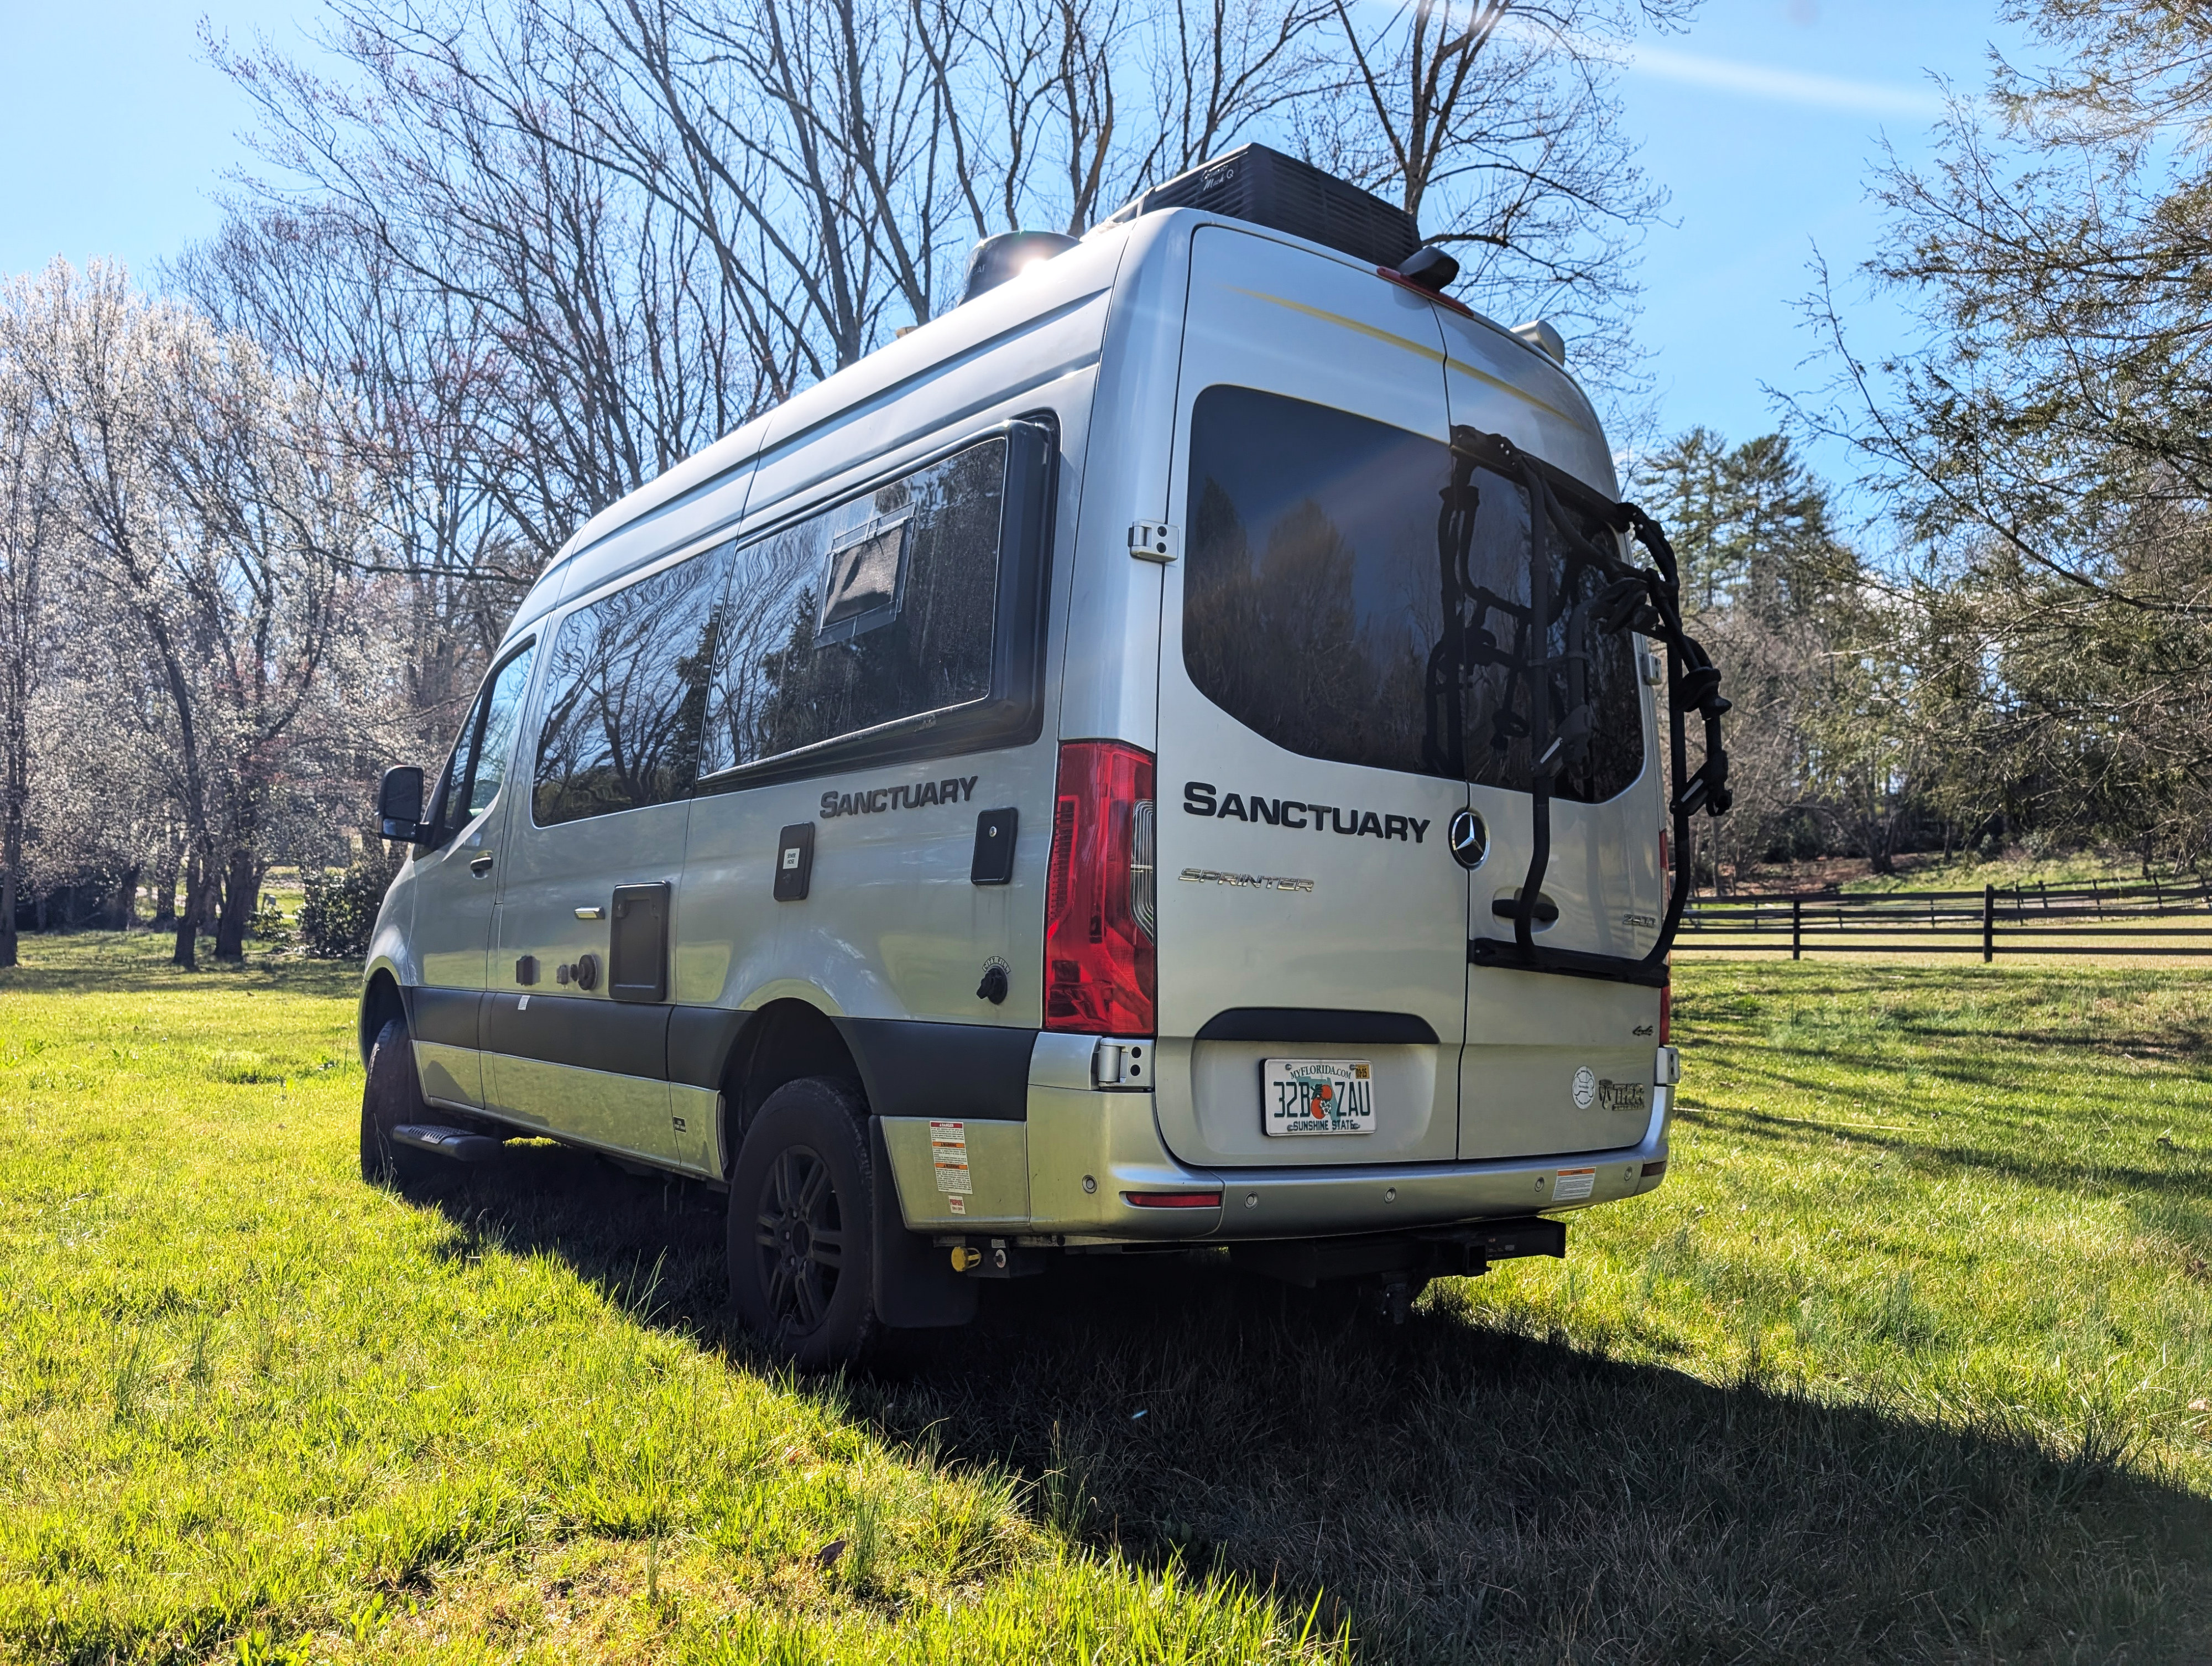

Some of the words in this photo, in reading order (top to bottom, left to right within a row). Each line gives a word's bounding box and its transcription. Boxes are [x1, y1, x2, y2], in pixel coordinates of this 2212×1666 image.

[820, 775, 978, 819] SANCTUARY
[1183, 781, 1431, 844] SANCTUARY
[1178, 868, 1314, 893] SPRINTER
[984, 957, 995, 970] CITY
[998, 957, 1008, 972] FILL
[1290, 1064, 1352, 1079] MYFLORIDA.COM
[1273, 1081, 1311, 1117] 32B
[1334, 1081, 1371, 1116] ZAU
[1293, 1120, 1329, 1131] SUNSHINE
[1332, 1119, 1354, 1130] STATE
